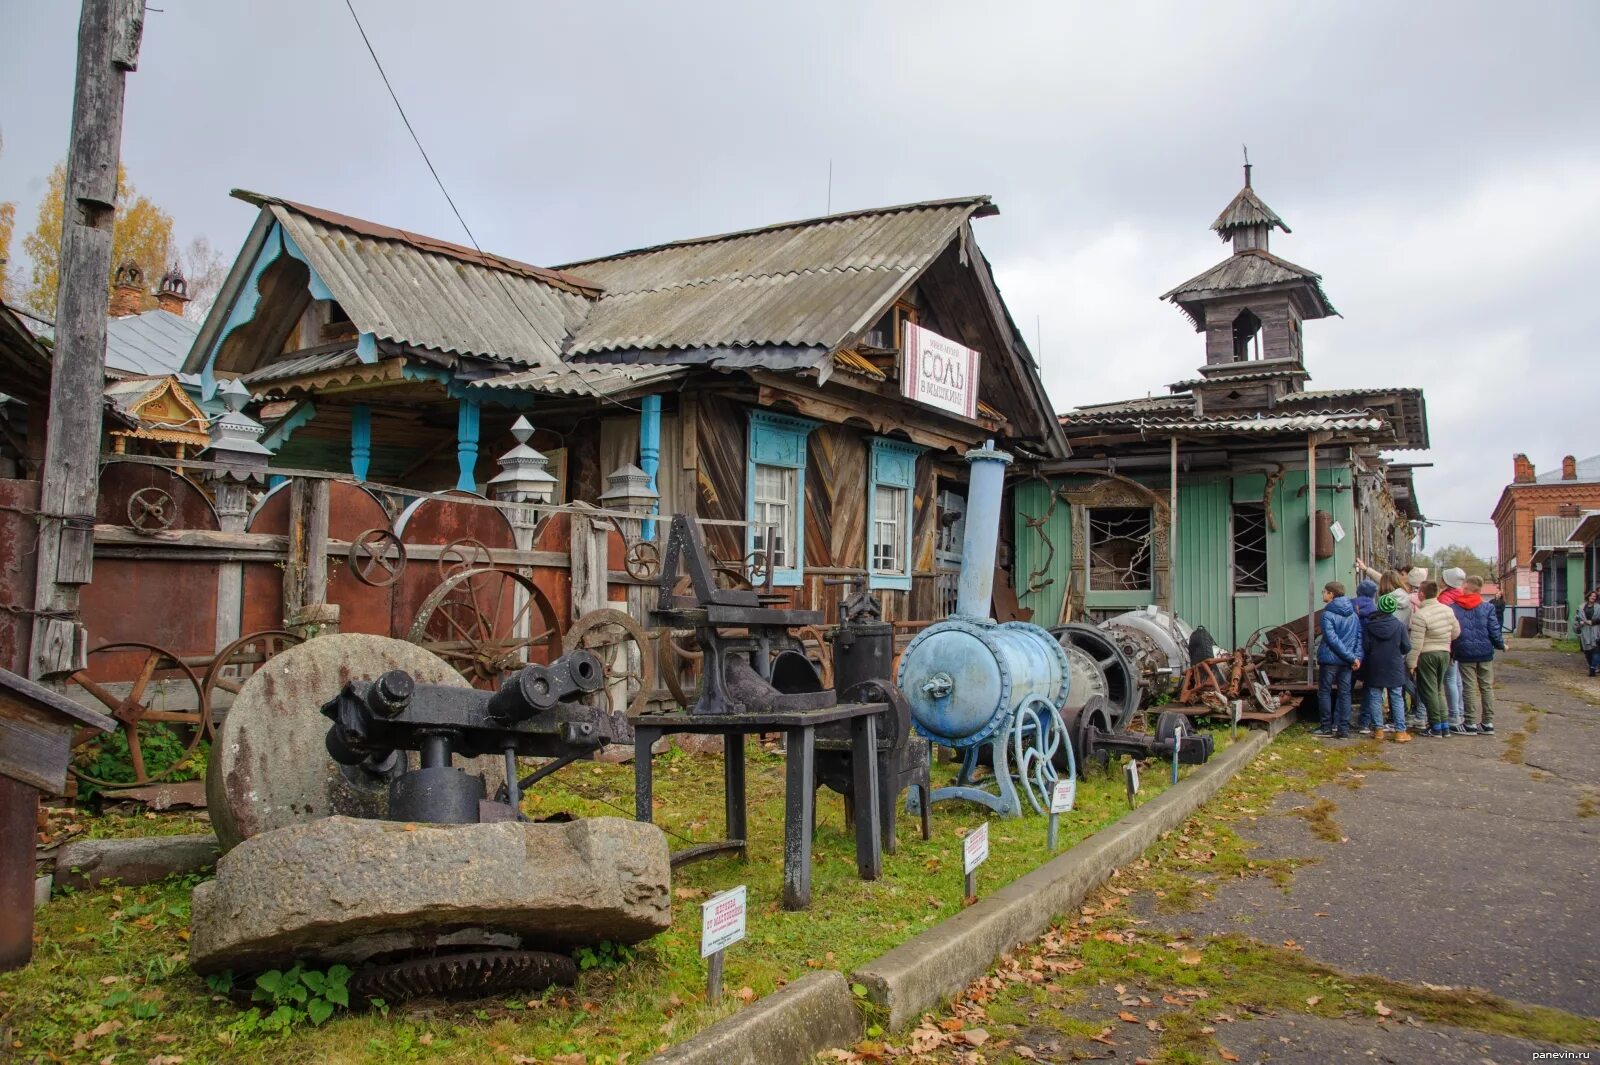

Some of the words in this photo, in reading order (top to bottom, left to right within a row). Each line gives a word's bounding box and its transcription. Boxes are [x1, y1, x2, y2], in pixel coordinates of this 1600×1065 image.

[922, 348, 964, 390] СОЛЬ
[920, 379, 926, 393] В
[926, 382, 963, 406] МЫШКИНЕ
